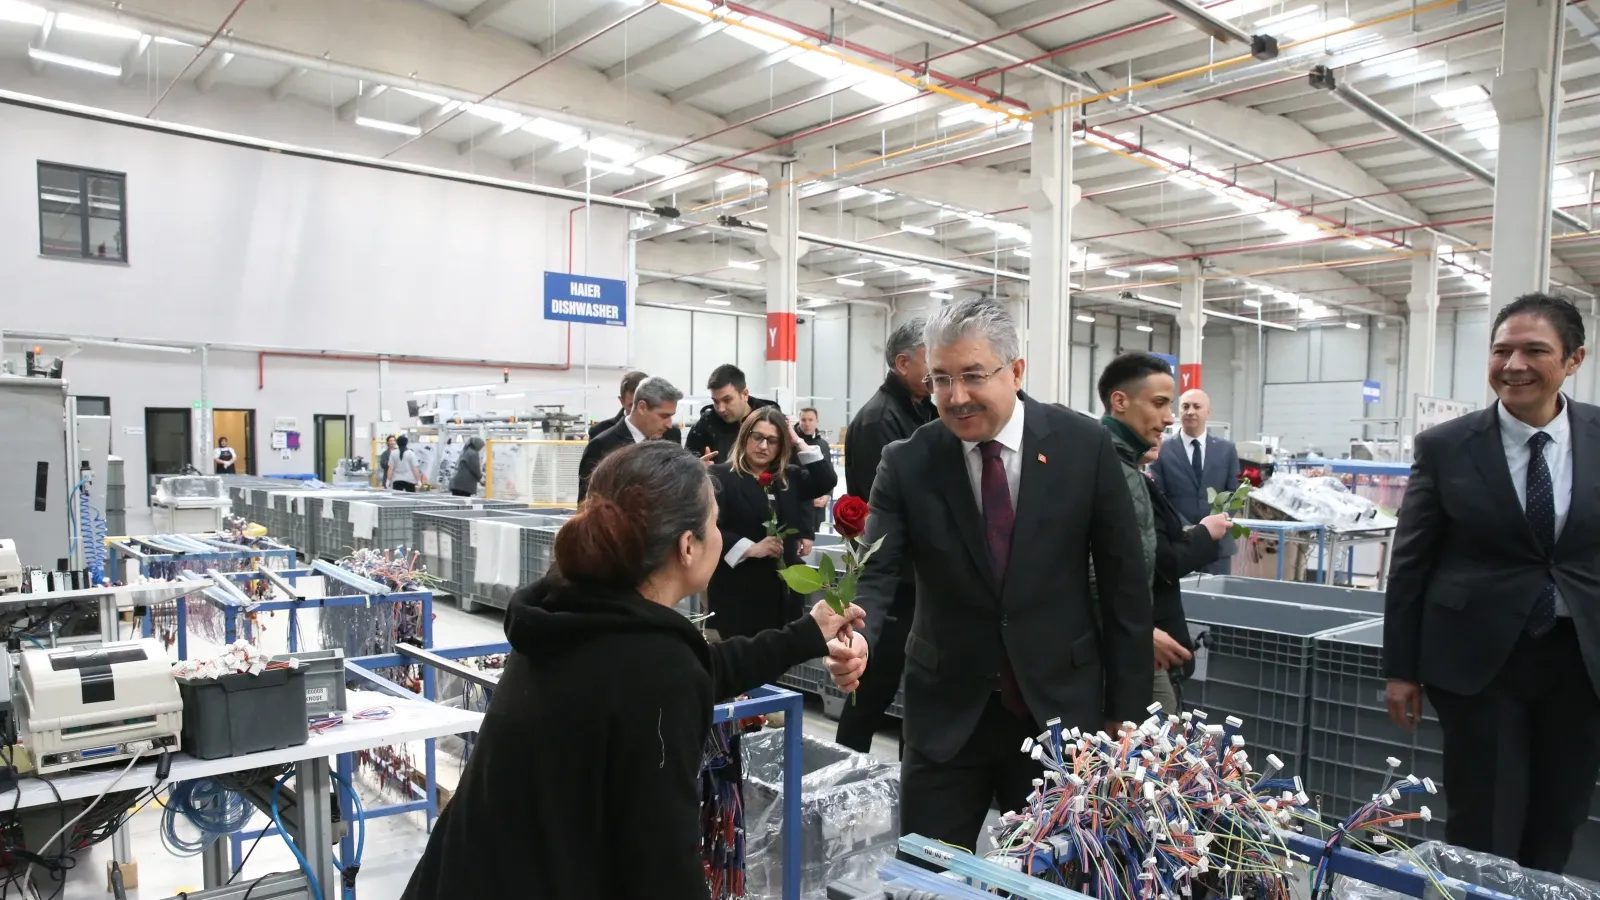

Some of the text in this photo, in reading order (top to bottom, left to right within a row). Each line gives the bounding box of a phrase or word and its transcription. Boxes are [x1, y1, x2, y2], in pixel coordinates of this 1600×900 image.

[570, 282, 601, 298] HAIER
[551, 299, 619, 319] DISHWASHER
[769, 327, 777, 347] Y
[1182, 373, 1190, 387] Y
